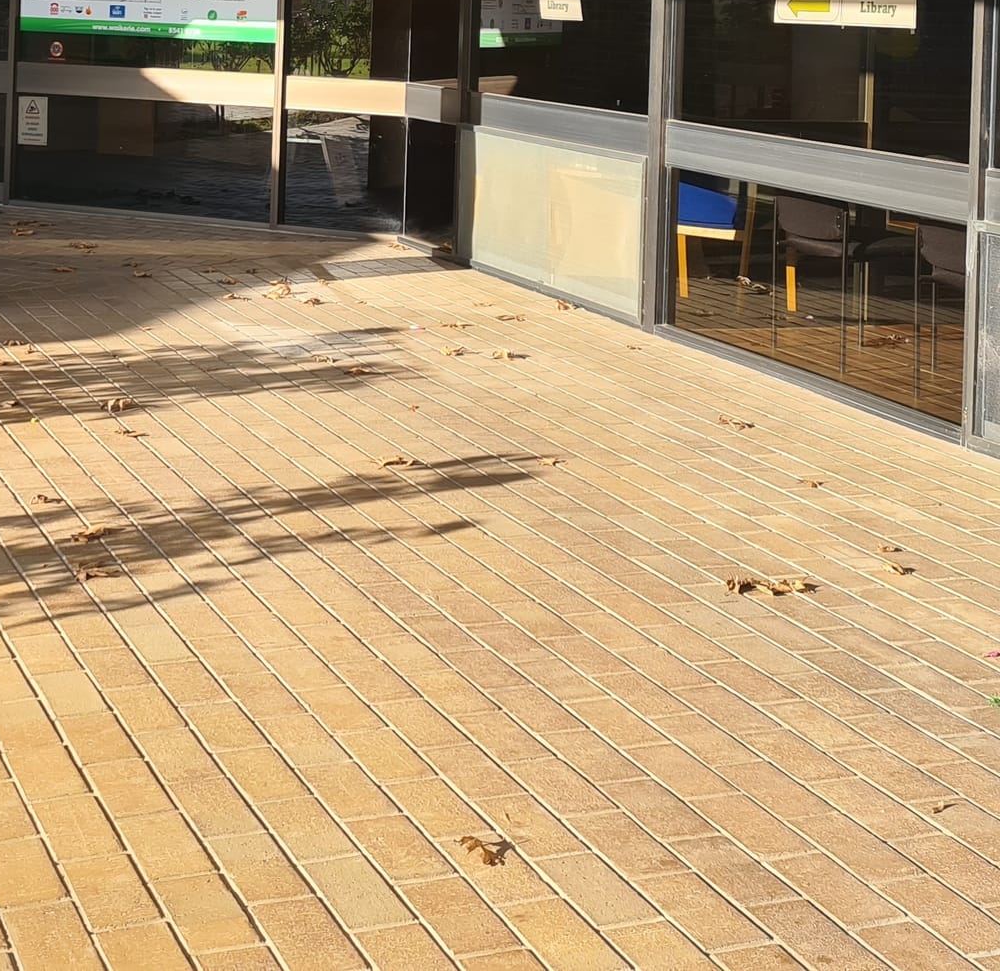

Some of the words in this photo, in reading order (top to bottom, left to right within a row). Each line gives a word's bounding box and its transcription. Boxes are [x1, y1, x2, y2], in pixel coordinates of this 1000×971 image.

[547, 0, 568, 12] Library
[860, 1, 897, 17] Library
[92, 24, 151, 33] www.waikerie.com
